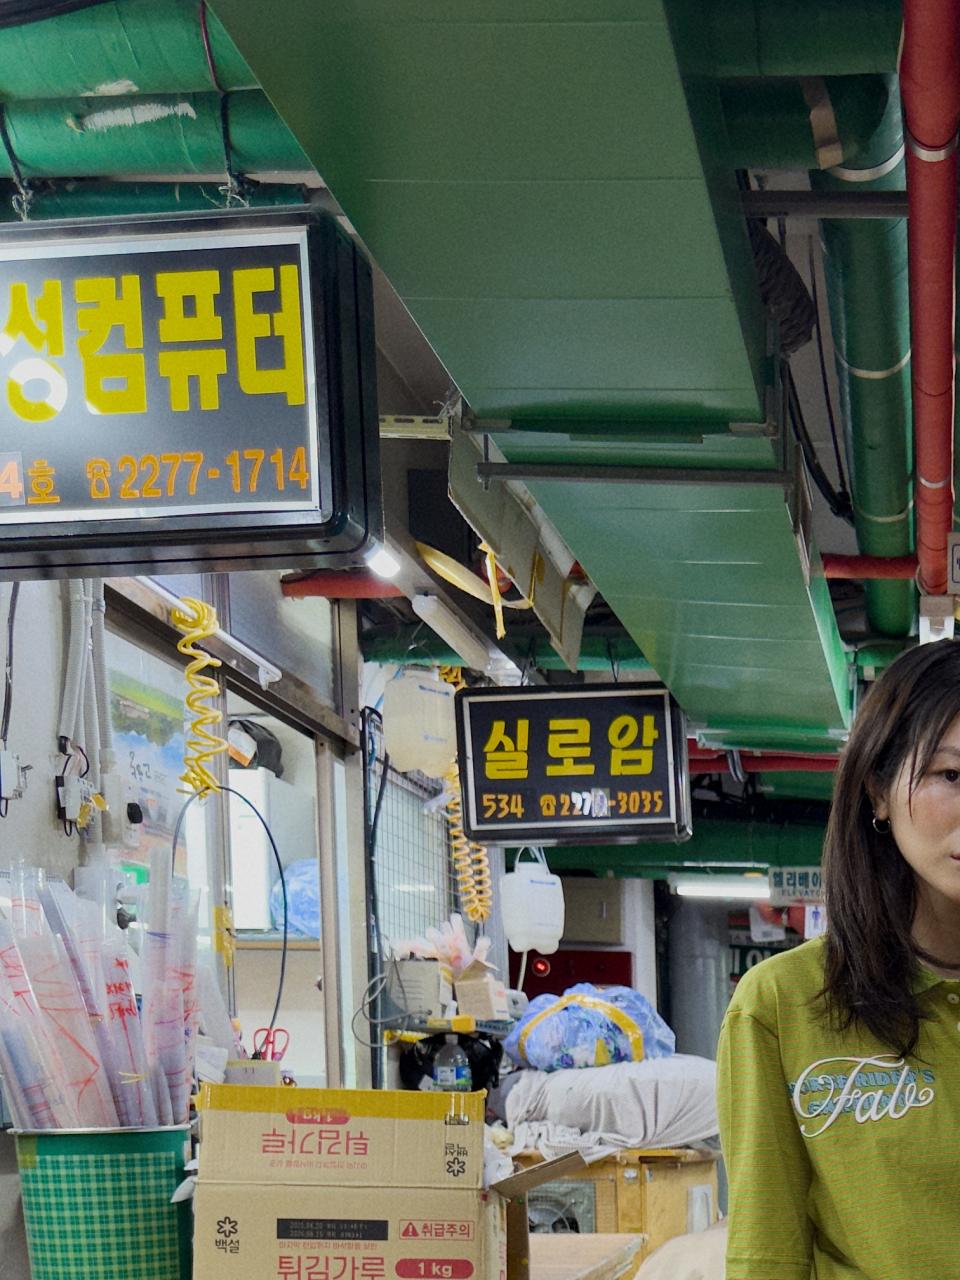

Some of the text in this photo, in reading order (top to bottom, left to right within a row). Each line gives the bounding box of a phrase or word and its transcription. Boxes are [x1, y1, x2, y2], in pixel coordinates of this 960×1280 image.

[3, 264, 306, 423] 성컴퓨터
[118, 446, 309, 499] 2277-1714
[483, 714, 659, 780] 실로암
[482, 793, 525, 819] 534
[773, 871, 822, 888] 엘리베이
[261, 1128, 369, 1156] 튀김가루
[421, 1222, 471, 1238] 취급주의
[214, 1239, 241, 1253] 백설
[432, 1261, 453, 1277] kg
